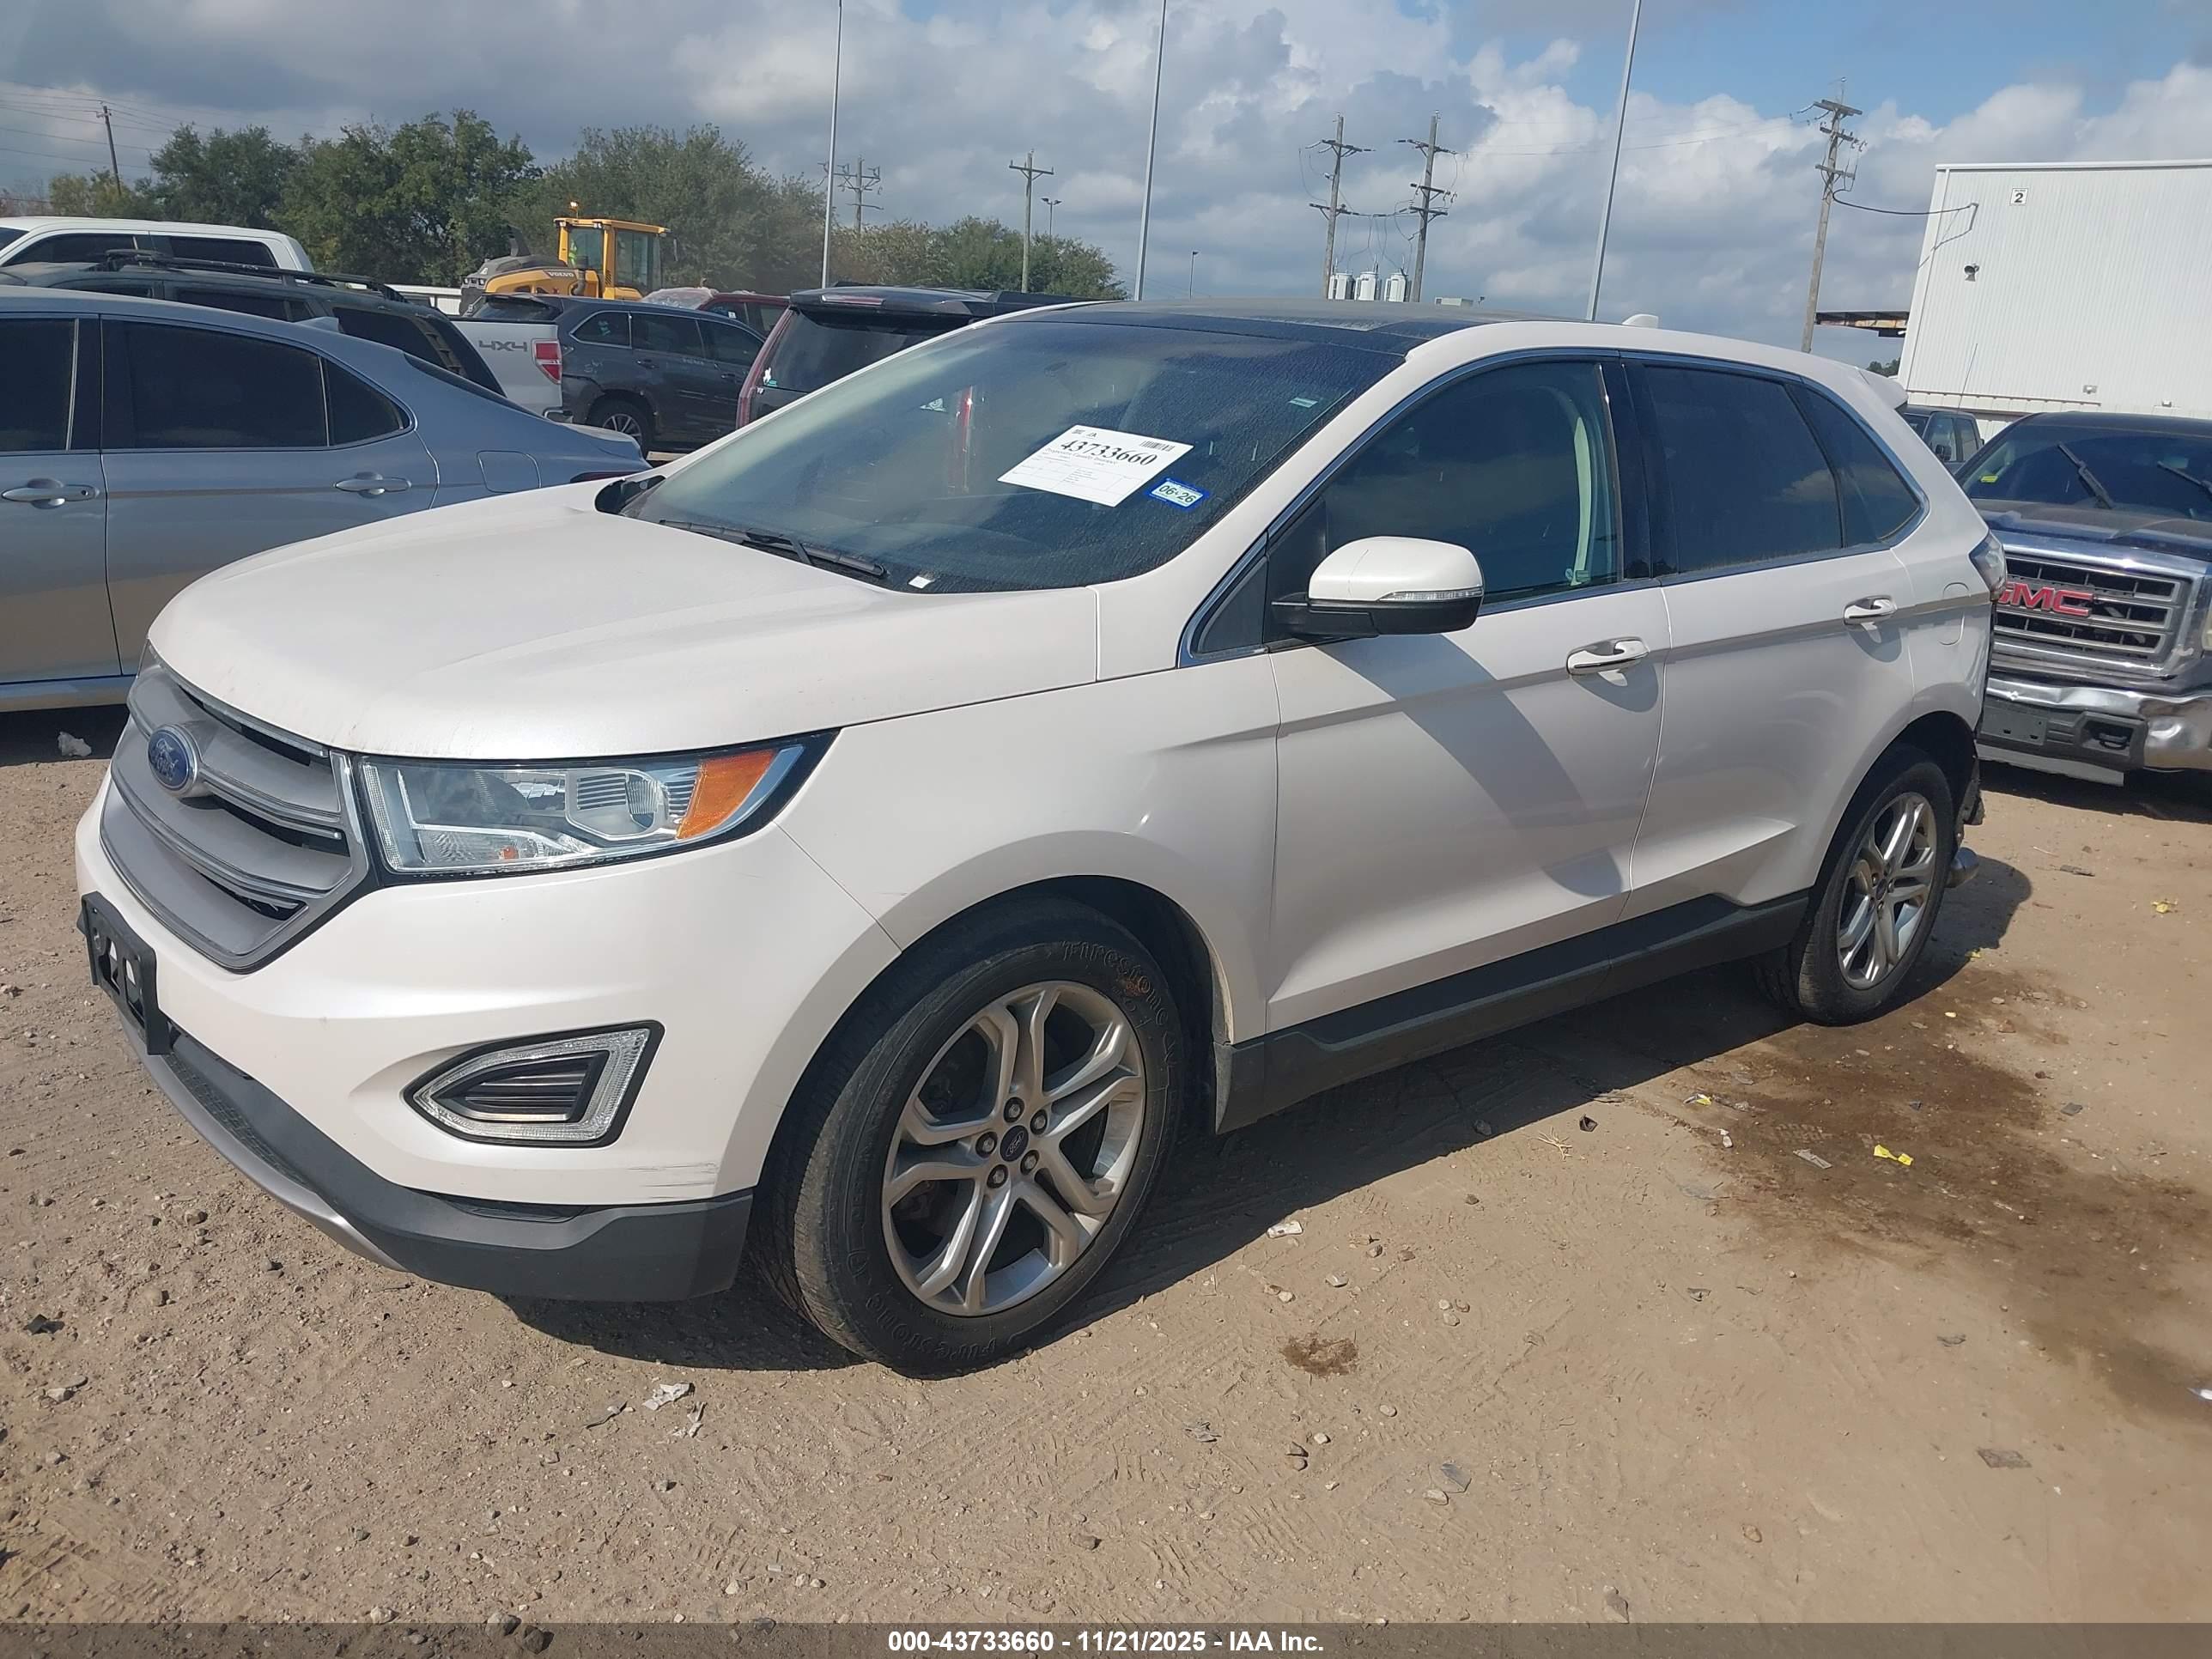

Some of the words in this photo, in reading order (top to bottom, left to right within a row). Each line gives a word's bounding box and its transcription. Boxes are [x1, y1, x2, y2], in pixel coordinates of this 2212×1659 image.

[2014, 192, 2024, 204] 2
[1060, 440, 1158, 466] 43733660
[1158, 484, 1178, 496] 06
[1176, 492, 1197, 504] 26
